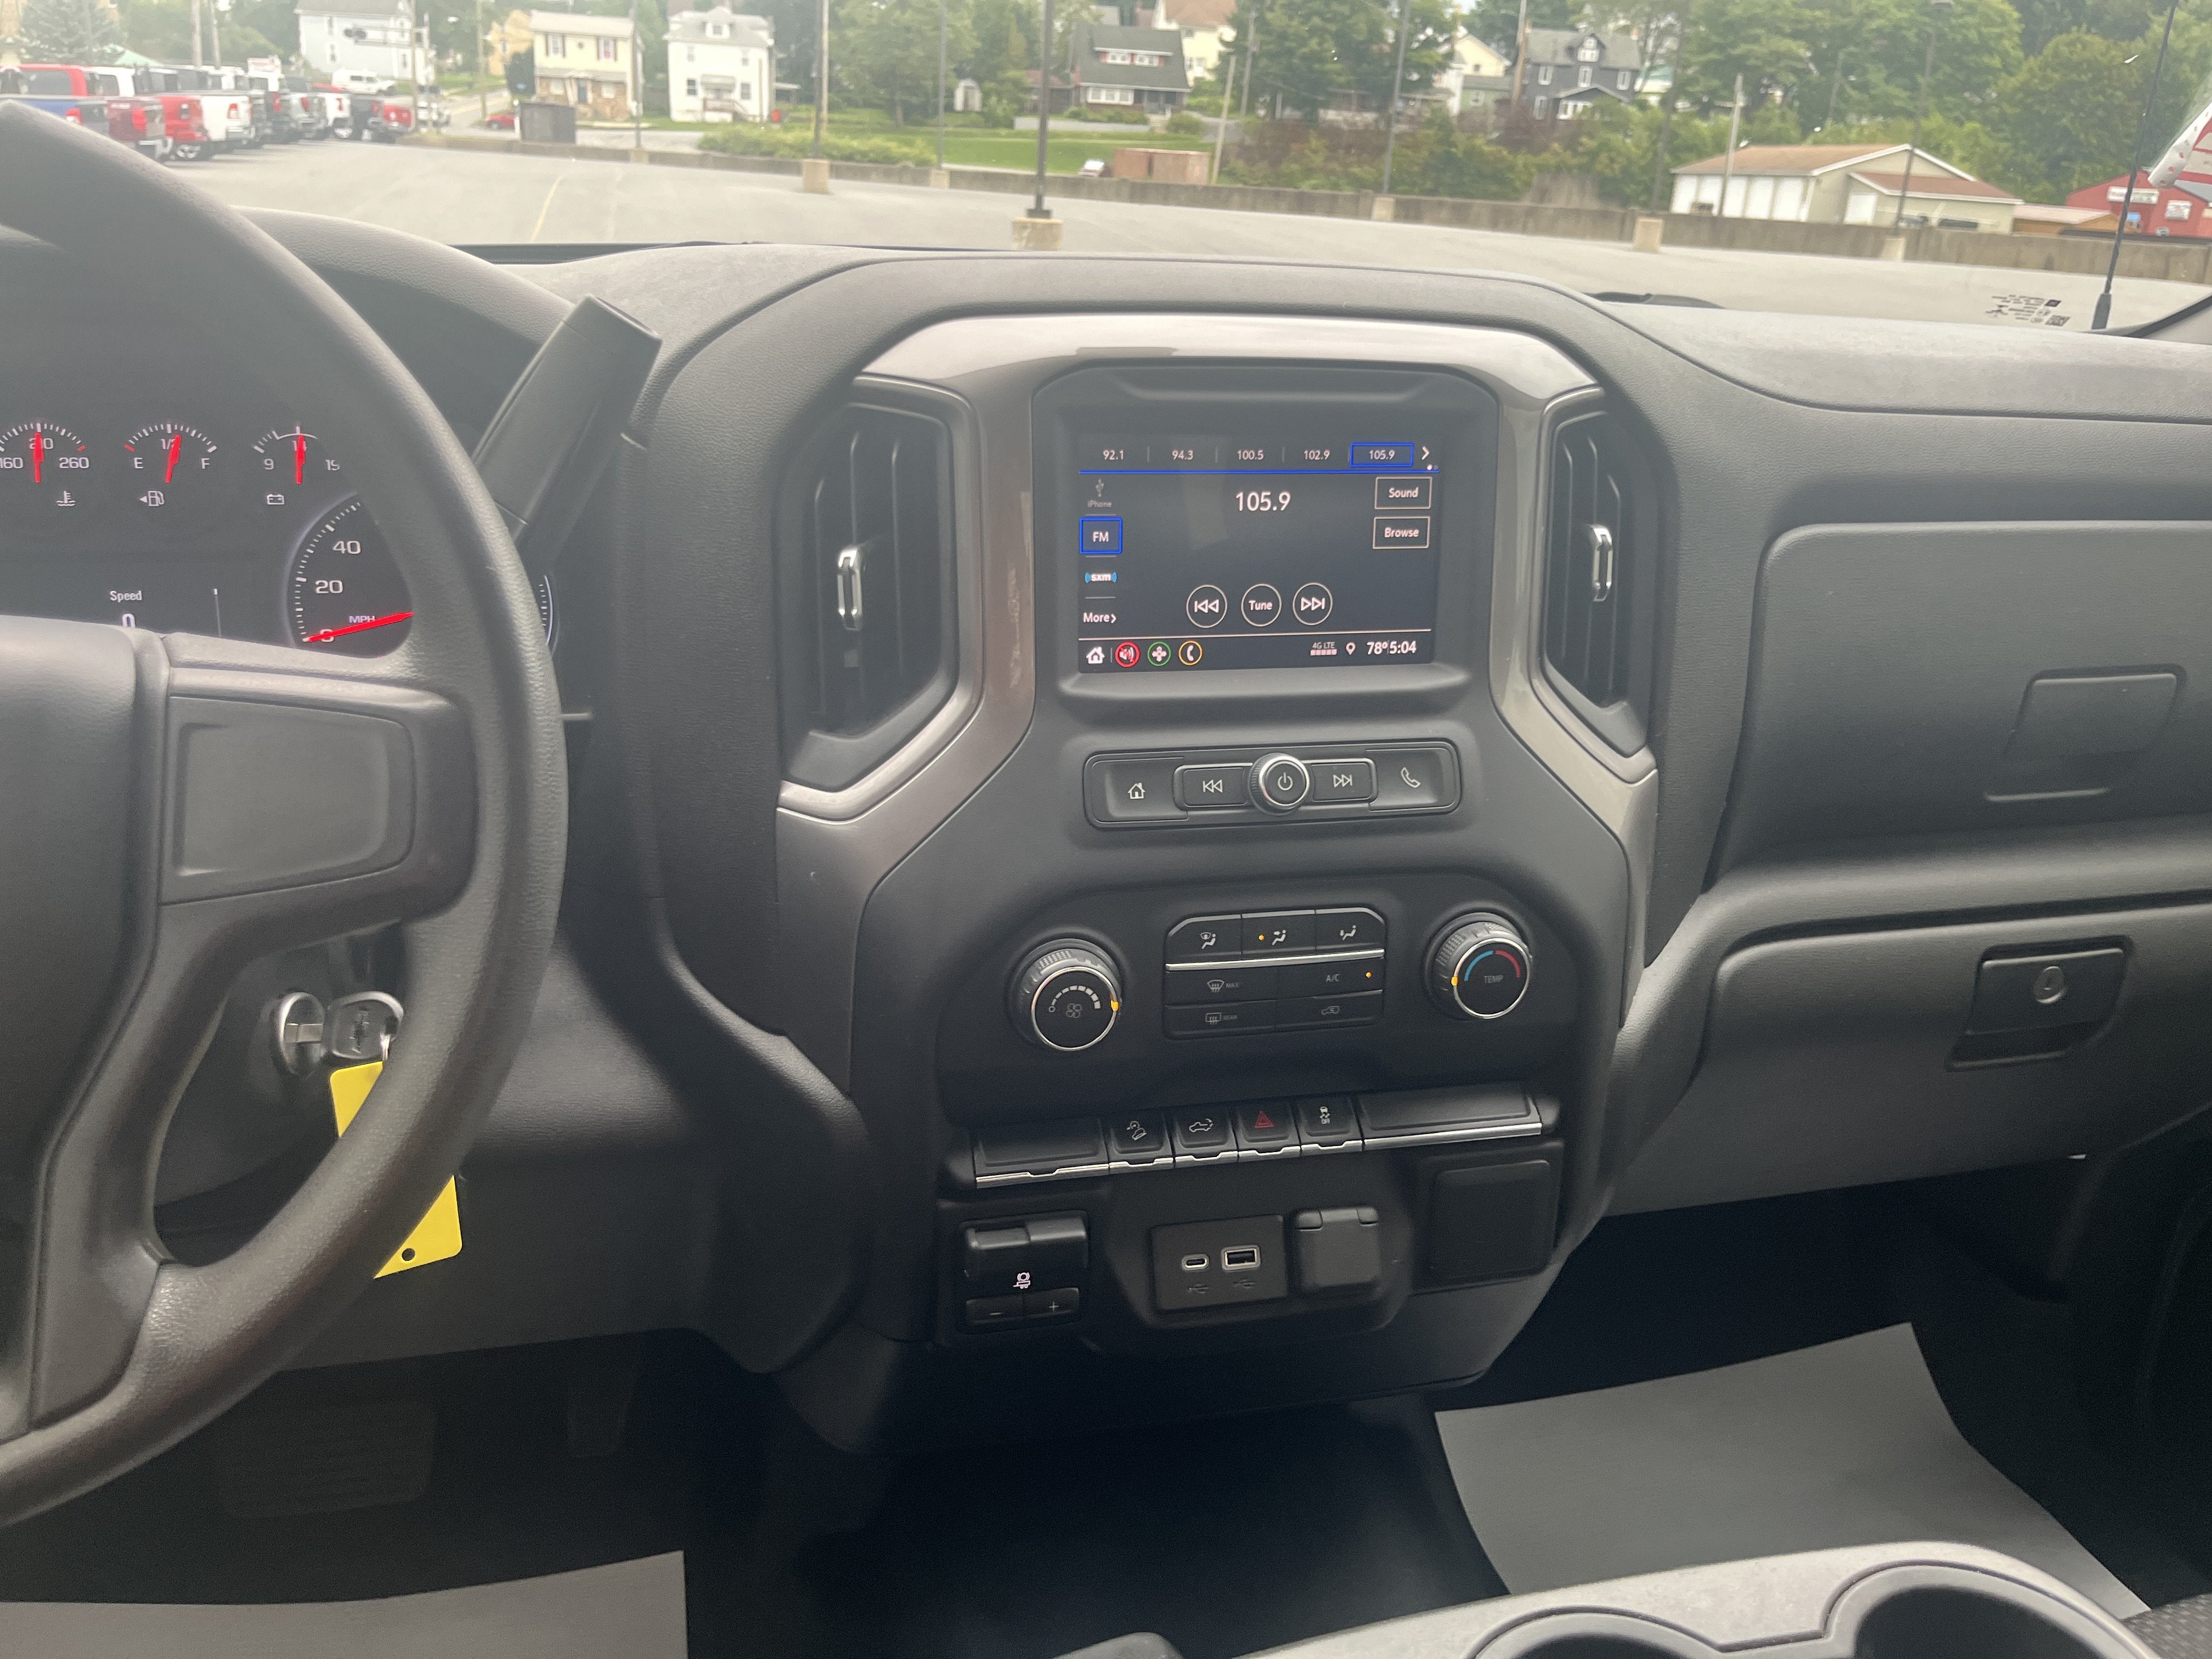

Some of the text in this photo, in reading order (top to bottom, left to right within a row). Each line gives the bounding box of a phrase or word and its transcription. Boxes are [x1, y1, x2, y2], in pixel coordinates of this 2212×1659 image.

[1103, 450, 1124, 460] 92.1
[1172, 450, 1194, 460] 94.3
[1237, 450, 1264, 460] 100.5
[1304, 449, 1330, 460] 102.9
[1369, 449, 1395, 460] 105.9
[59, 457, 89, 469] 260
[134, 457, 144, 469] E
[201, 458, 210, 469] F
[264, 459, 274, 470] 9
[1389, 487, 1419, 498] Sound
[1236, 492, 1290, 511] 105.9
[1093, 531, 1109, 542] FM
[1384, 527, 1419, 538] Browse
[332, 540, 361, 554] 40
[315, 580, 343, 594] 20
[110, 590, 142, 602] Speed
[1248, 600, 1273, 611] Tune
[1083, 612, 1110, 622] More
[1389, 641, 1417, 654] 5:04
[1325, 974, 1339, 983] A/C
[1483, 975, 1504, 983] TEMP
